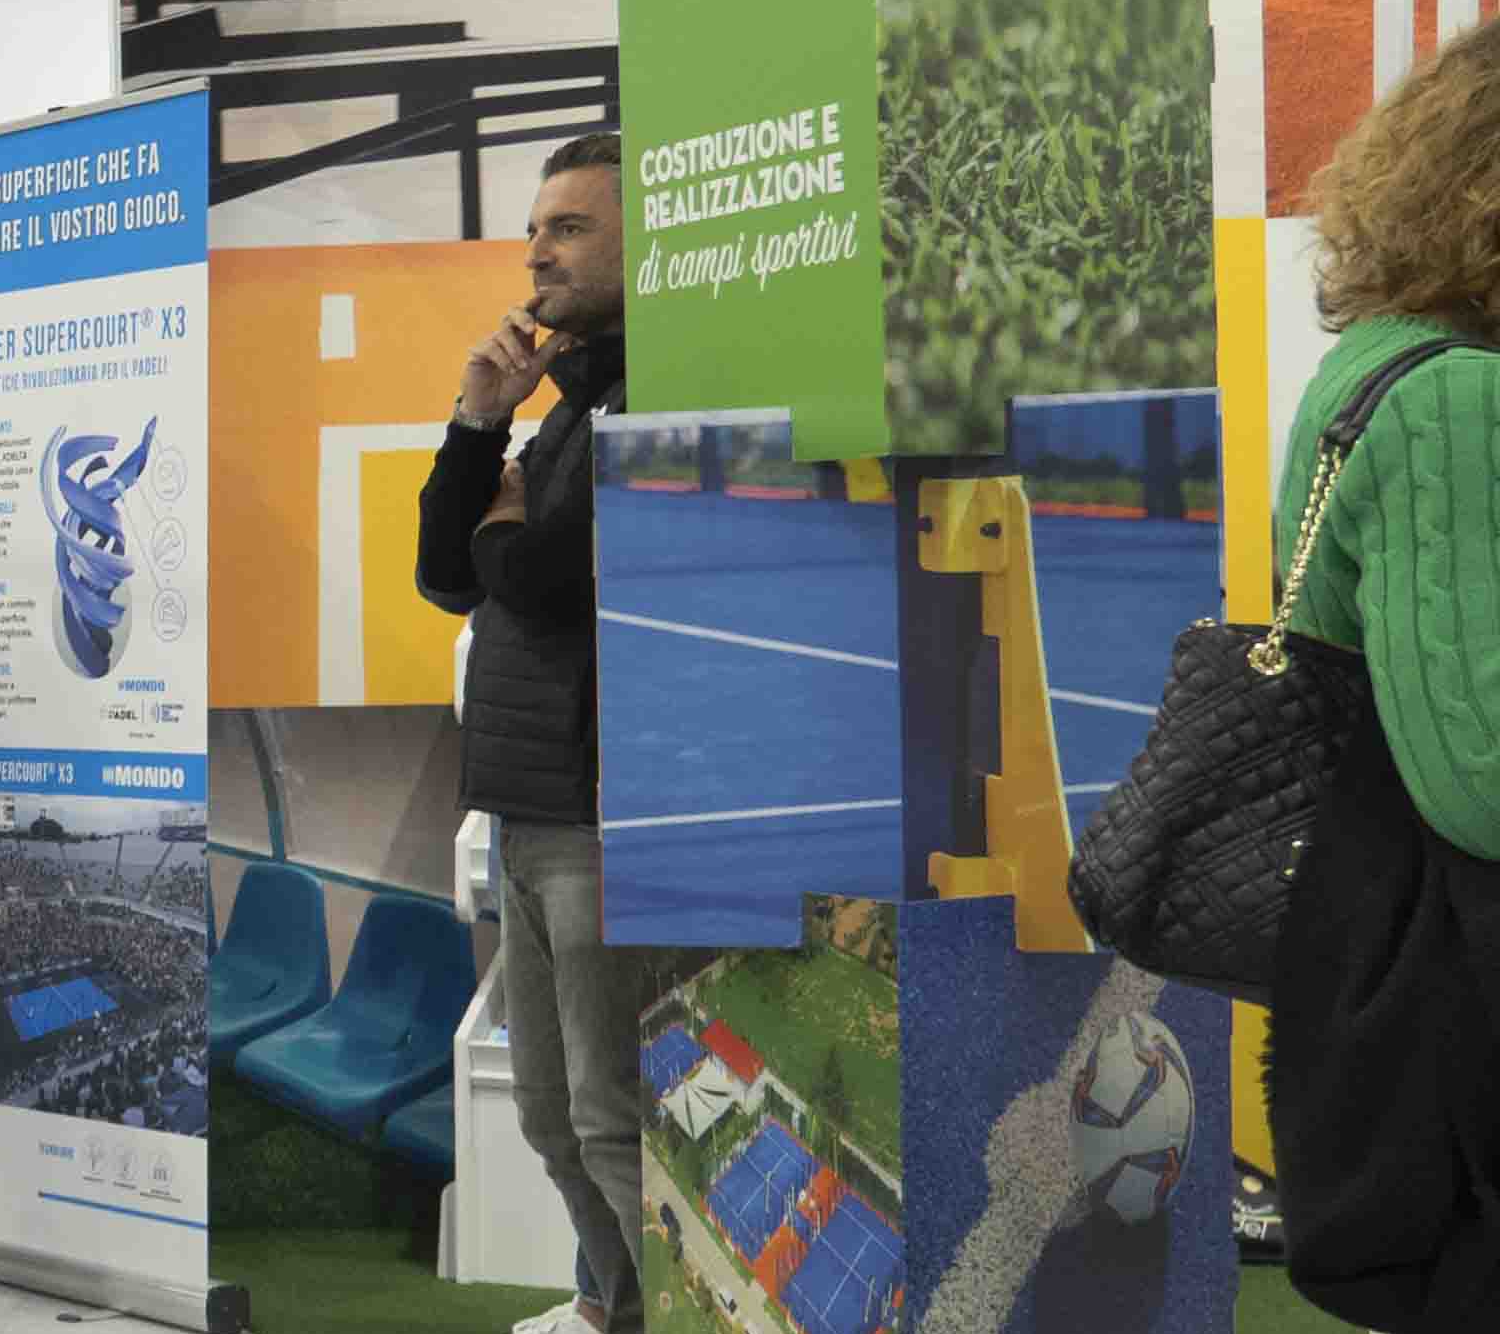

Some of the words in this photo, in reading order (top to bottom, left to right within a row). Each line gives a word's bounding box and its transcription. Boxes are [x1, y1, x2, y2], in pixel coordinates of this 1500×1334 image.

[97, 148, 132, 185] CHE
[137, 141, 161, 177] FA
[639, 108, 816, 187] COSTRUZIONE
[821, 102, 841, 145] E
[644, 151, 845, 231] REALIZZAZIONE
[27, 216, 45, 247] IL
[50, 201, 118, 243] VOSTRO
[123, 190, 186, 231] GIOCO.
[636, 237, 662, 296] di
[667, 232, 746, 300] campi
[750, 210, 858, 292] sportivi
[160, 305, 187, 340] X3
[59, 763, 75, 784] X3
[115, 765, 185, 789] MONDO
